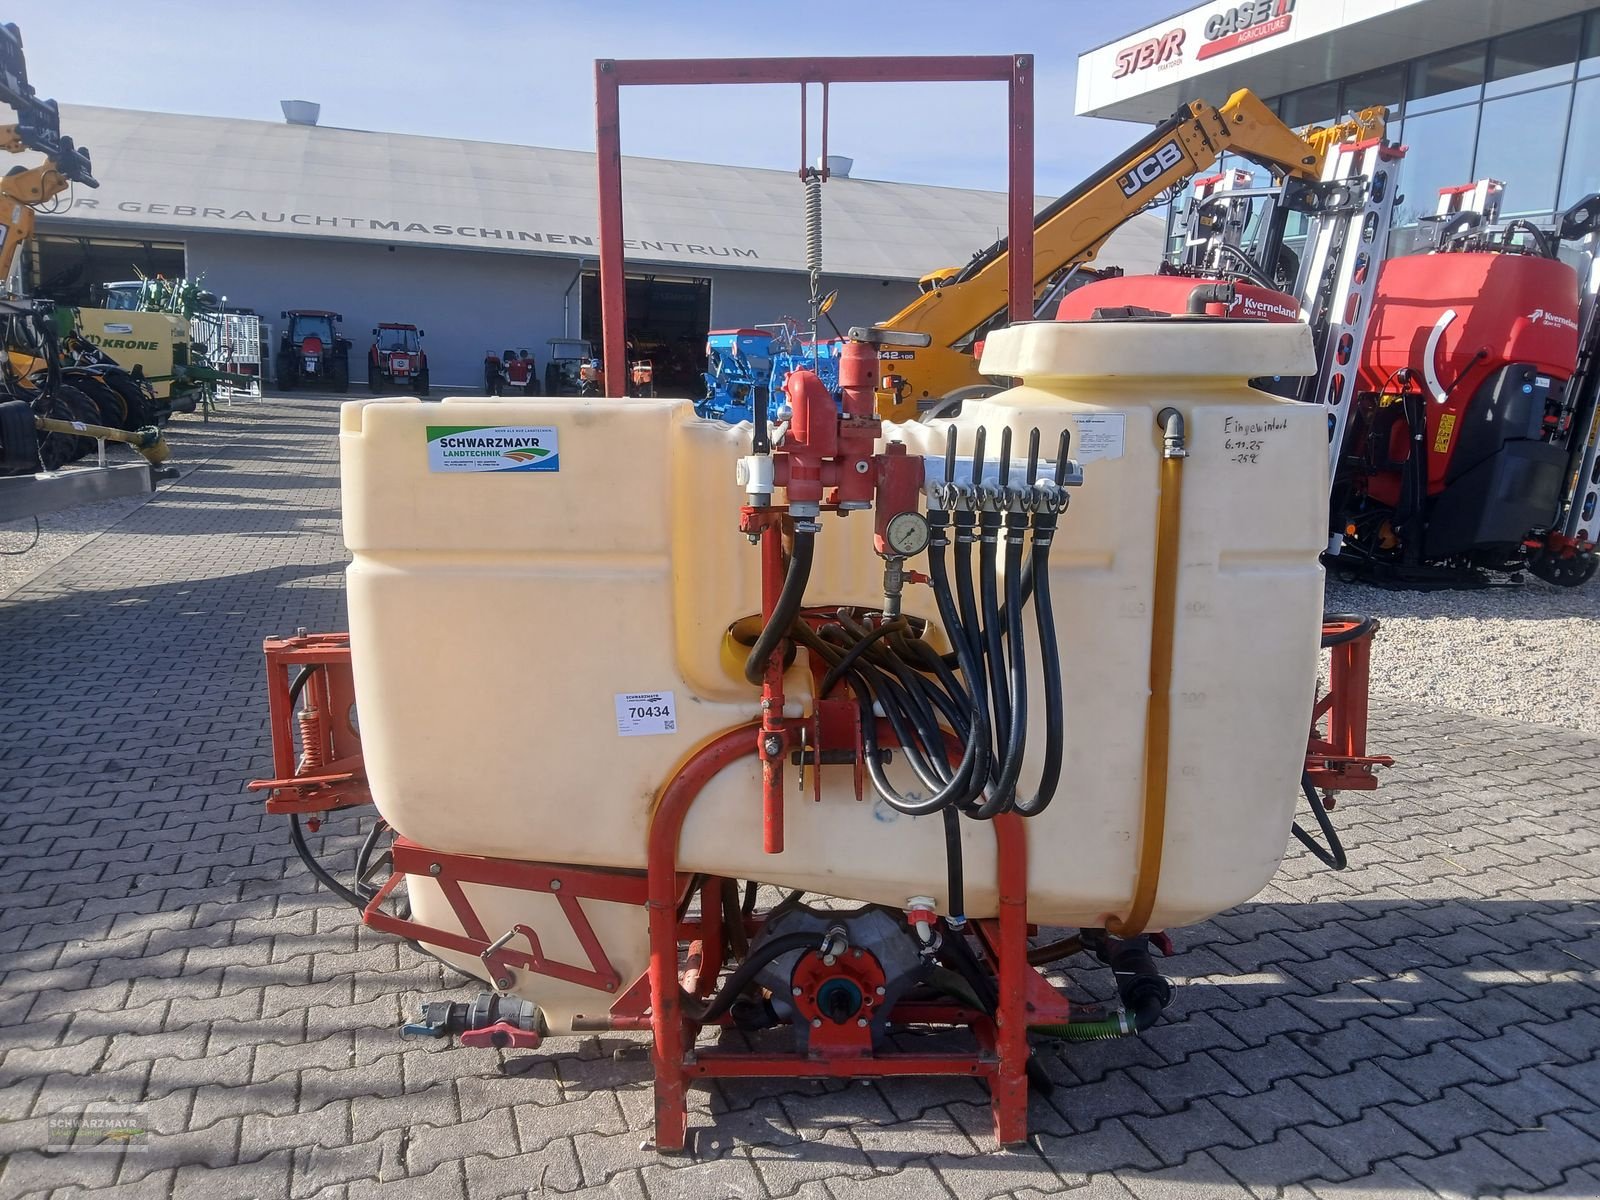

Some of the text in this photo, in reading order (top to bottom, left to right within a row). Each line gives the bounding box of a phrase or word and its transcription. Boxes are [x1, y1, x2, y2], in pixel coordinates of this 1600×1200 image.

[1204, 0, 1271, 41] CASE
[1237, 18, 1287, 44] AGRICULTURE
[1112, 27, 1187, 80] STEYR
[1157, 59, 1184, 72] TRAKTOREN
[1124, 143, 1182, 195] JCB
[118, 201, 760, 259] GEBRAUCHTMASCHINENENTRUM
[1244, 297, 1297, 319] Kverneland
[102, 338, 159, 351] KRONE
[440, 437, 540, 448] SCHWARZMAYR
[1225, 438, 1264, 451] 6.11.25
[629, 705, 670, 719] 70434
